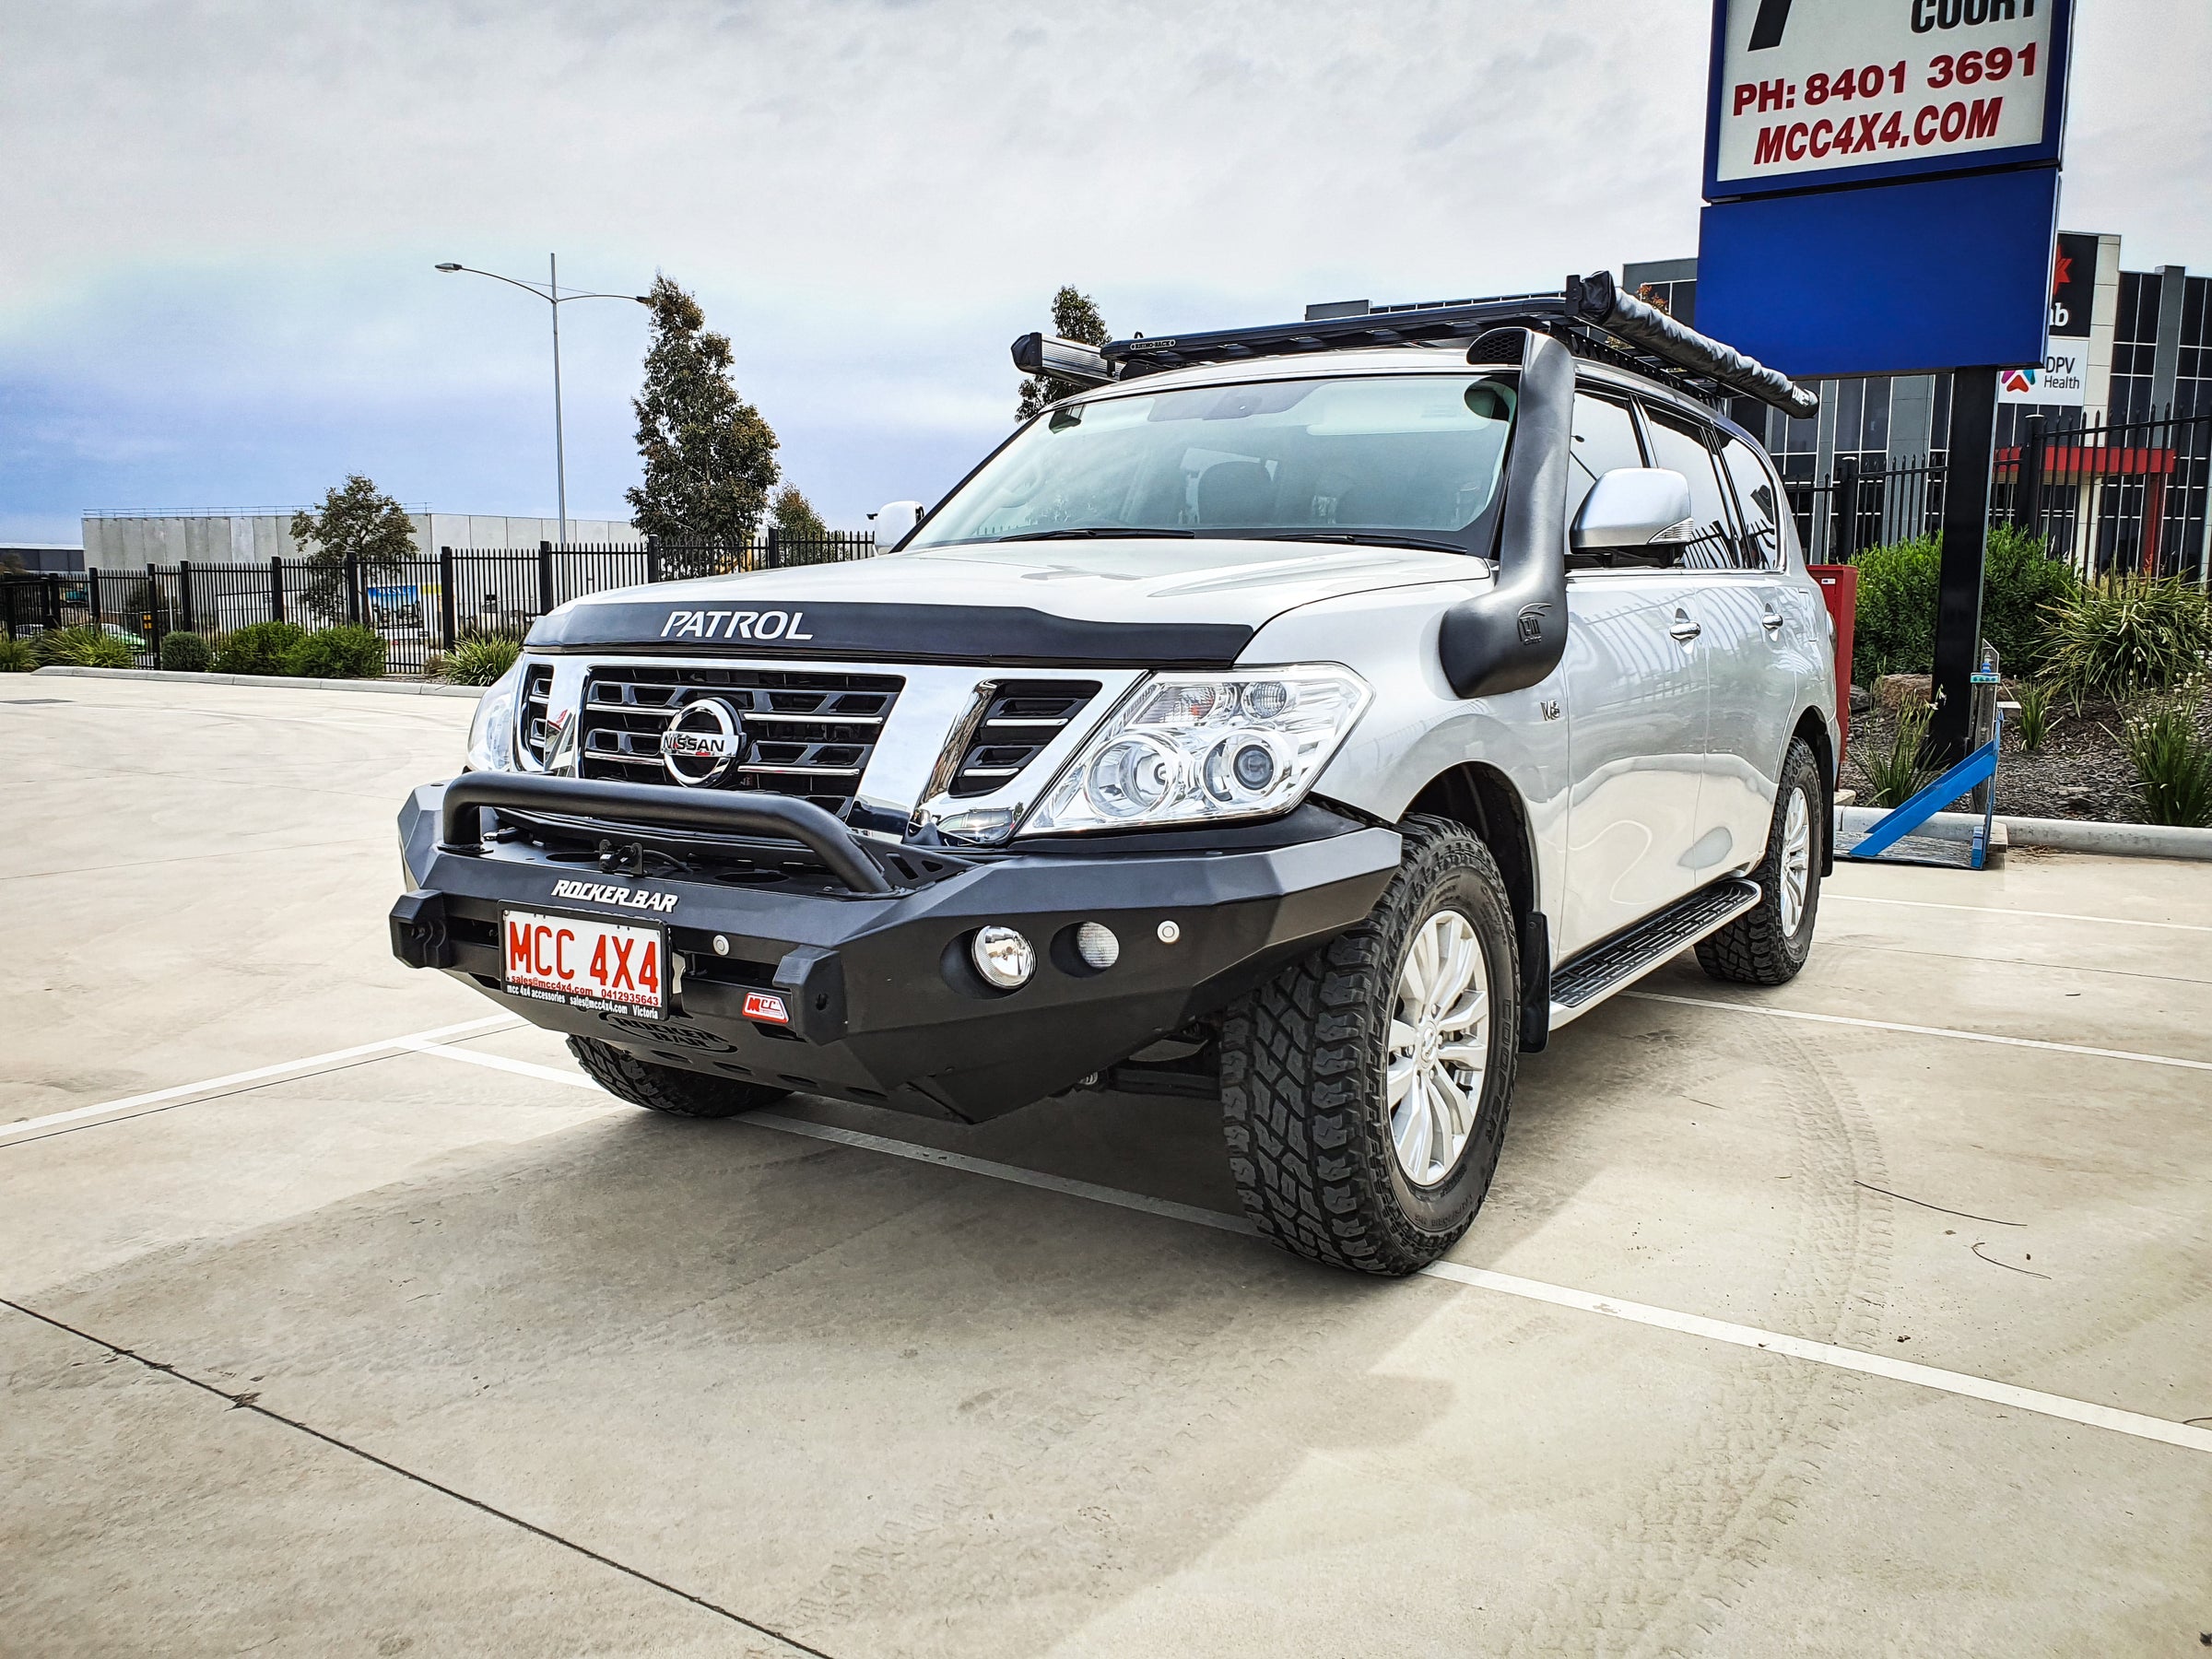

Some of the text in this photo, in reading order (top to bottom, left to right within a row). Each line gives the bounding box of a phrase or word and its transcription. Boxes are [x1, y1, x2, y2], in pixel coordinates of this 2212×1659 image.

[1733, 41, 2037, 116] PH: 8401 3691
[1753, 96, 2004, 166] MCC4X4.COM
[2045, 357, 2076, 374] DPV
[2043, 375, 2080, 390] Health
[660, 610, 814, 641] PATROL
[663, 738, 725, 752] NISSAN
[551, 879, 678, 913] ROCKER BAR
[509, 921, 659, 994] MCC 4X4
[507, 985, 659, 1019] mcc 4x4 accessories sales@mcc4x4.com Victoria
[511, 974, 660, 1006] sales@mcc4x4.com 0412935643
[747, 997, 781, 1012] MCC
